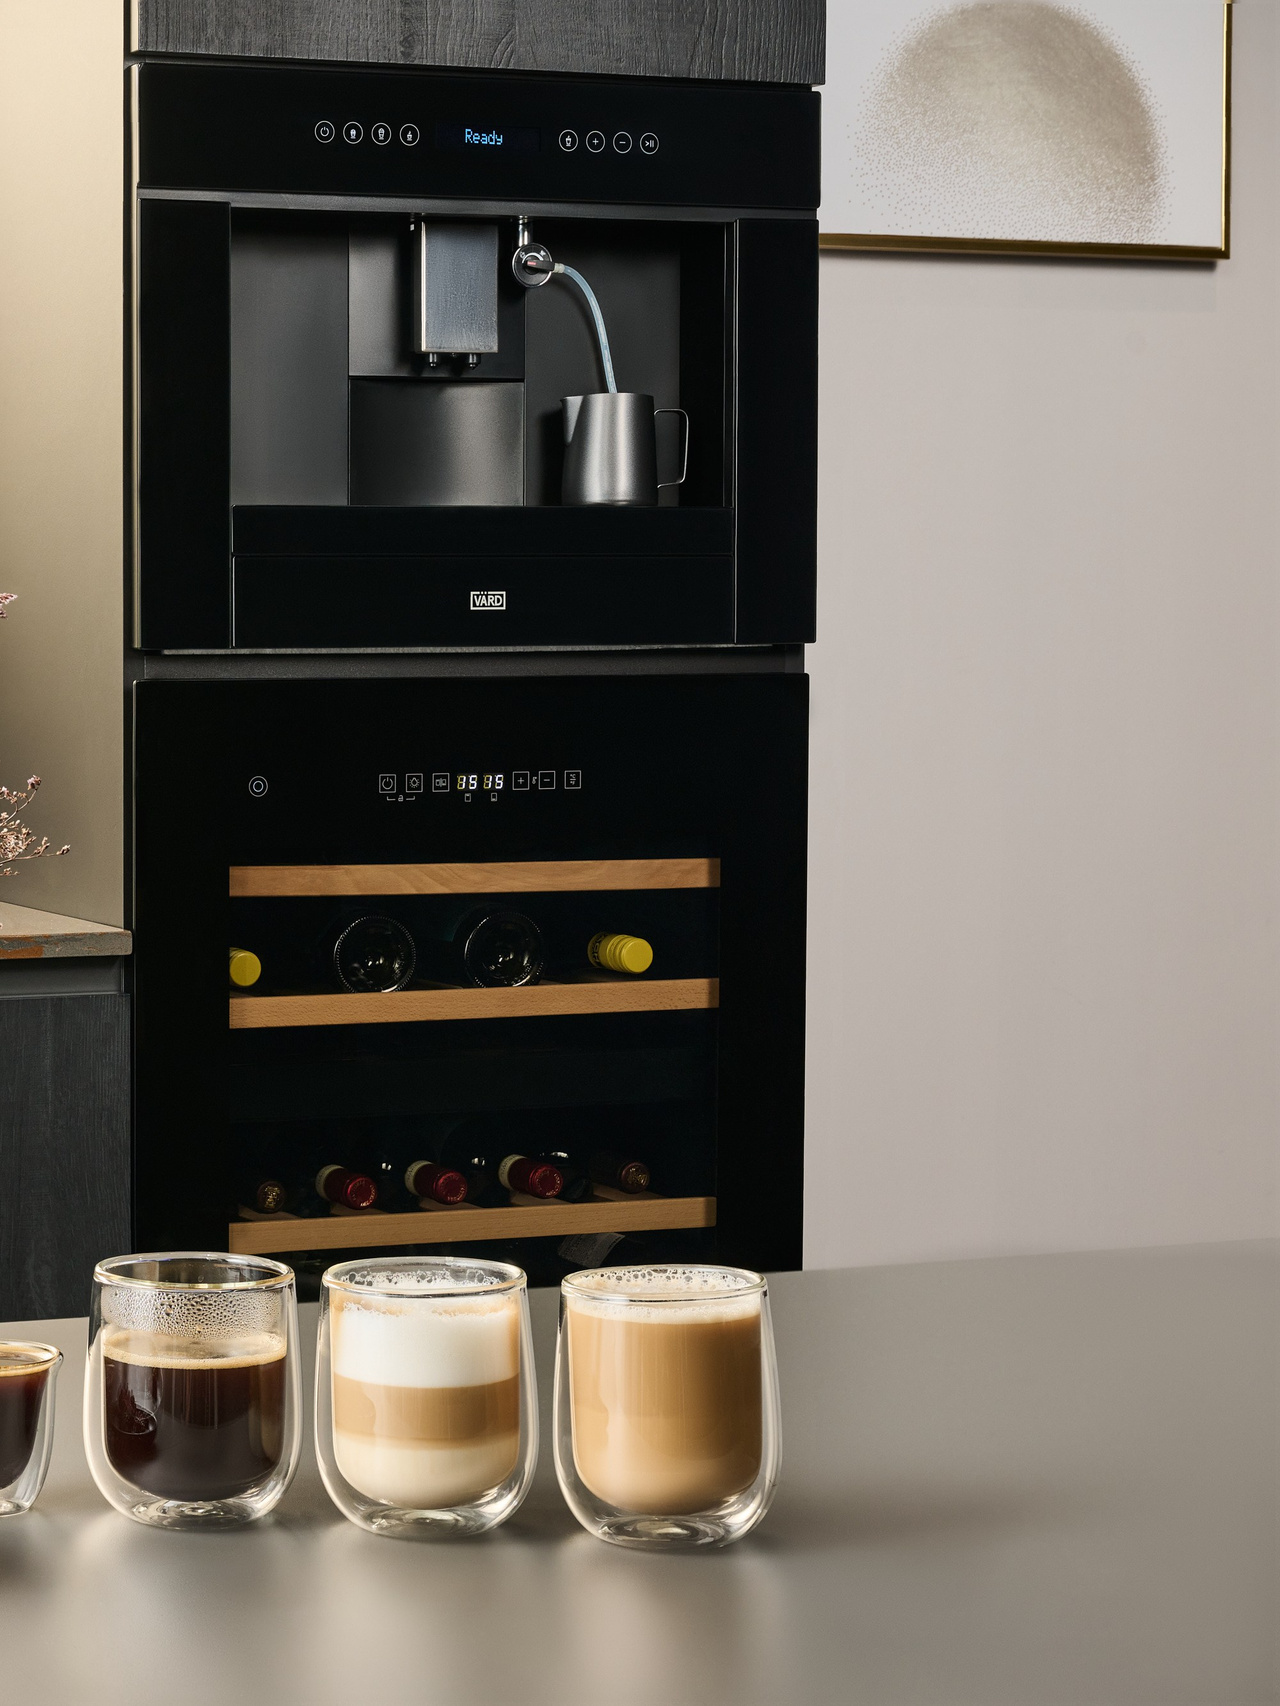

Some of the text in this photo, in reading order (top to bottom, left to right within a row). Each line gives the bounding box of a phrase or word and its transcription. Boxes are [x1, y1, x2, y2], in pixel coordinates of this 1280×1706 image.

[465, 128, 503, 145] Ready
[457, 774, 504, 790] 15 15
